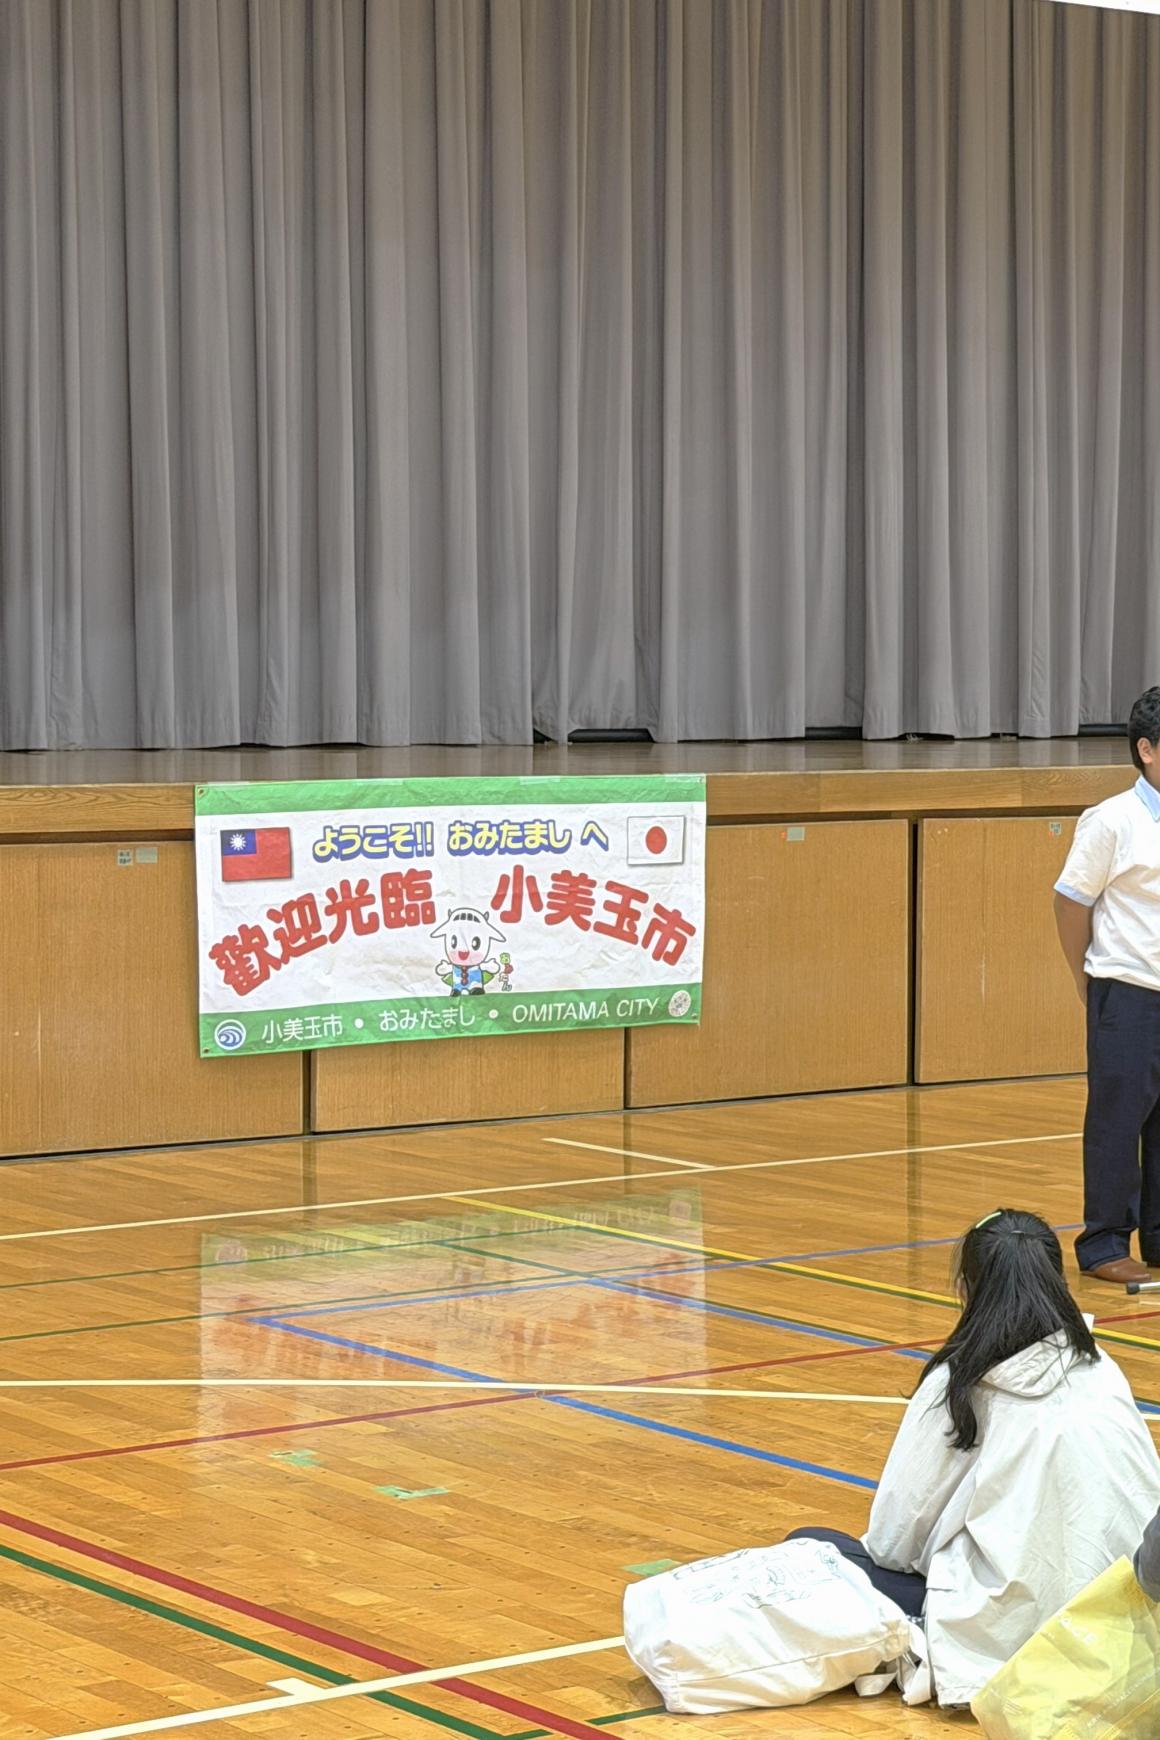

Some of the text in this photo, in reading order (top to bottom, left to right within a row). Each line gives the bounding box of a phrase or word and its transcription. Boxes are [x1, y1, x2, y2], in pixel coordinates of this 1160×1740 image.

[447, 819, 571, 856] おみたまし
[580, 820, 609, 851] へ
[208, 864, 697, 997] 歡迎光臨 小美玉市
[261, 997, 660, 1044] 小美玉市 おみたまし OMITAMA CITY
